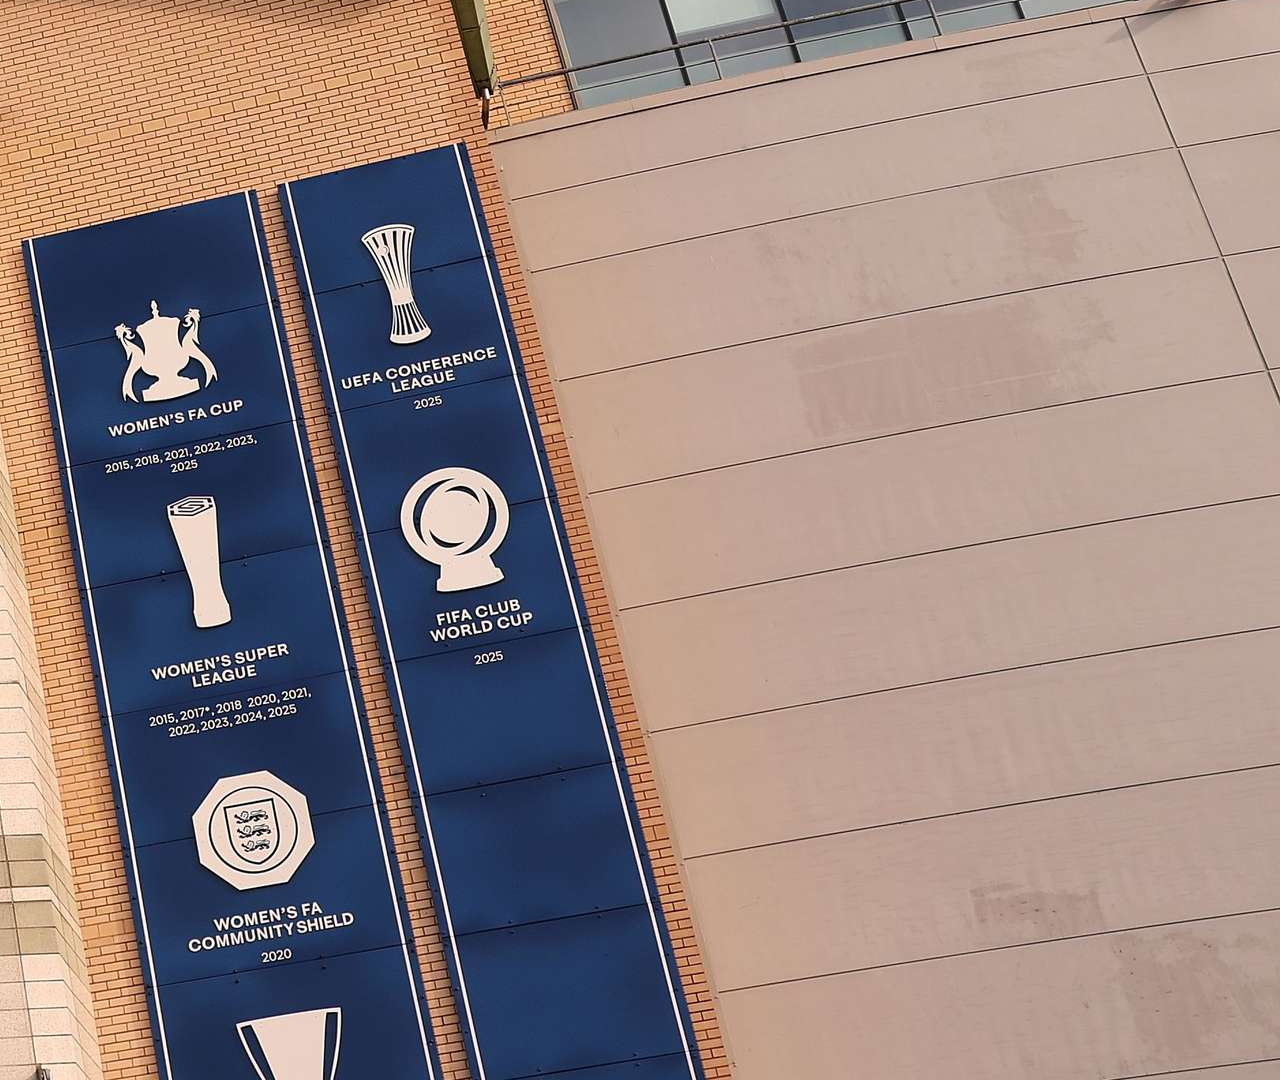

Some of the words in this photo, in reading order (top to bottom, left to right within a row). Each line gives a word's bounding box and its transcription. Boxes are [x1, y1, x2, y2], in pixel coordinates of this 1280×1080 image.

[341, 372, 383, 389] UEFA
[386, 347, 496, 380] CONFERENCE
[391, 369, 456, 393] LEAGUE
[414, 395, 443, 410] 2025
[108, 412, 185, 437] WOMEN'S
[188, 408, 207, 421] FA
[210, 399, 243, 416] CUP
[105, 461, 133, 474] 2015,
[134, 455, 163, 468] 2018,
[164, 448, 193, 461] 2021,
[193, 441, 225, 455] 2022,
[226, 434, 258, 449] 2023,
[170, 459, 198, 473] 2025
[429, 620, 493, 642] WORLD
[497, 612, 533, 629] CUP
[436, 608, 472, 626] FIFA
[475, 599, 521, 618] CLUB
[151, 654, 232, 680] WOMEN'S
[235, 643, 289, 664] SUPER
[474, 651, 504, 665] 2025
[192, 664, 257, 688] LEAGUE
[149, 713, 179, 727] 2015,
[216, 700, 242, 714] 2018
[247, 693, 281, 708] 2020,
[281, 687, 312, 702] 2021,
[168, 723, 200, 737] 2022,
[201, 717, 233, 731] 2023,
[234, 710, 266, 724] 2024,
[268, 704, 297, 718] 2025
[188, 922, 294, 952] COMMUNITY
[296, 912, 354, 934] SHIELD
[213, 905, 298, 932] WOMEN'S
[301, 902, 323, 917] FA
[261, 948, 292, 963] 2020
